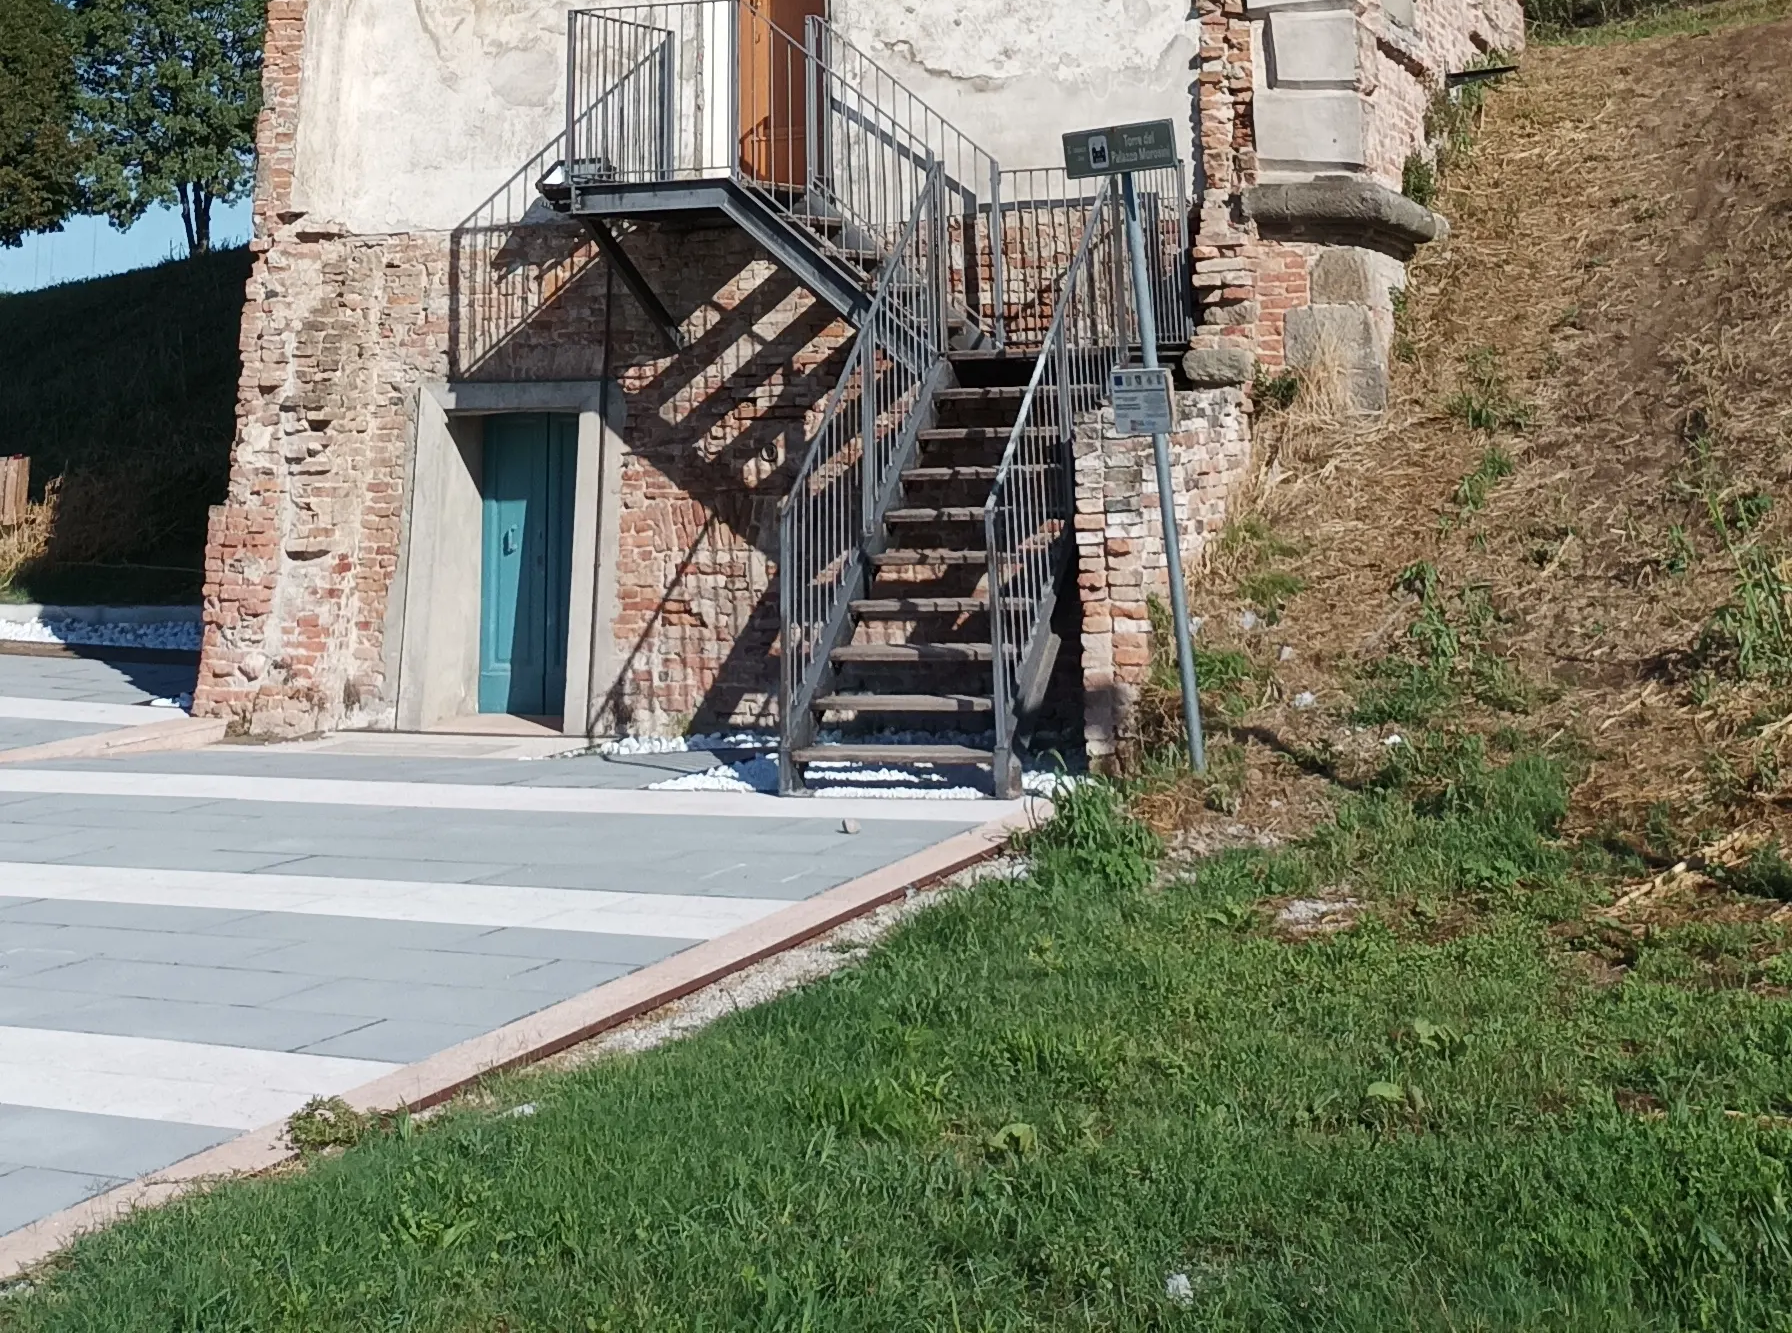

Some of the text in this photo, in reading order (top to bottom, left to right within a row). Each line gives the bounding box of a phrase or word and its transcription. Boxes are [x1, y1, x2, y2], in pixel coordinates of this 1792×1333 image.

[1122, 131, 1155, 147] Torre del
[1111, 149, 1138, 164] Palazzo
